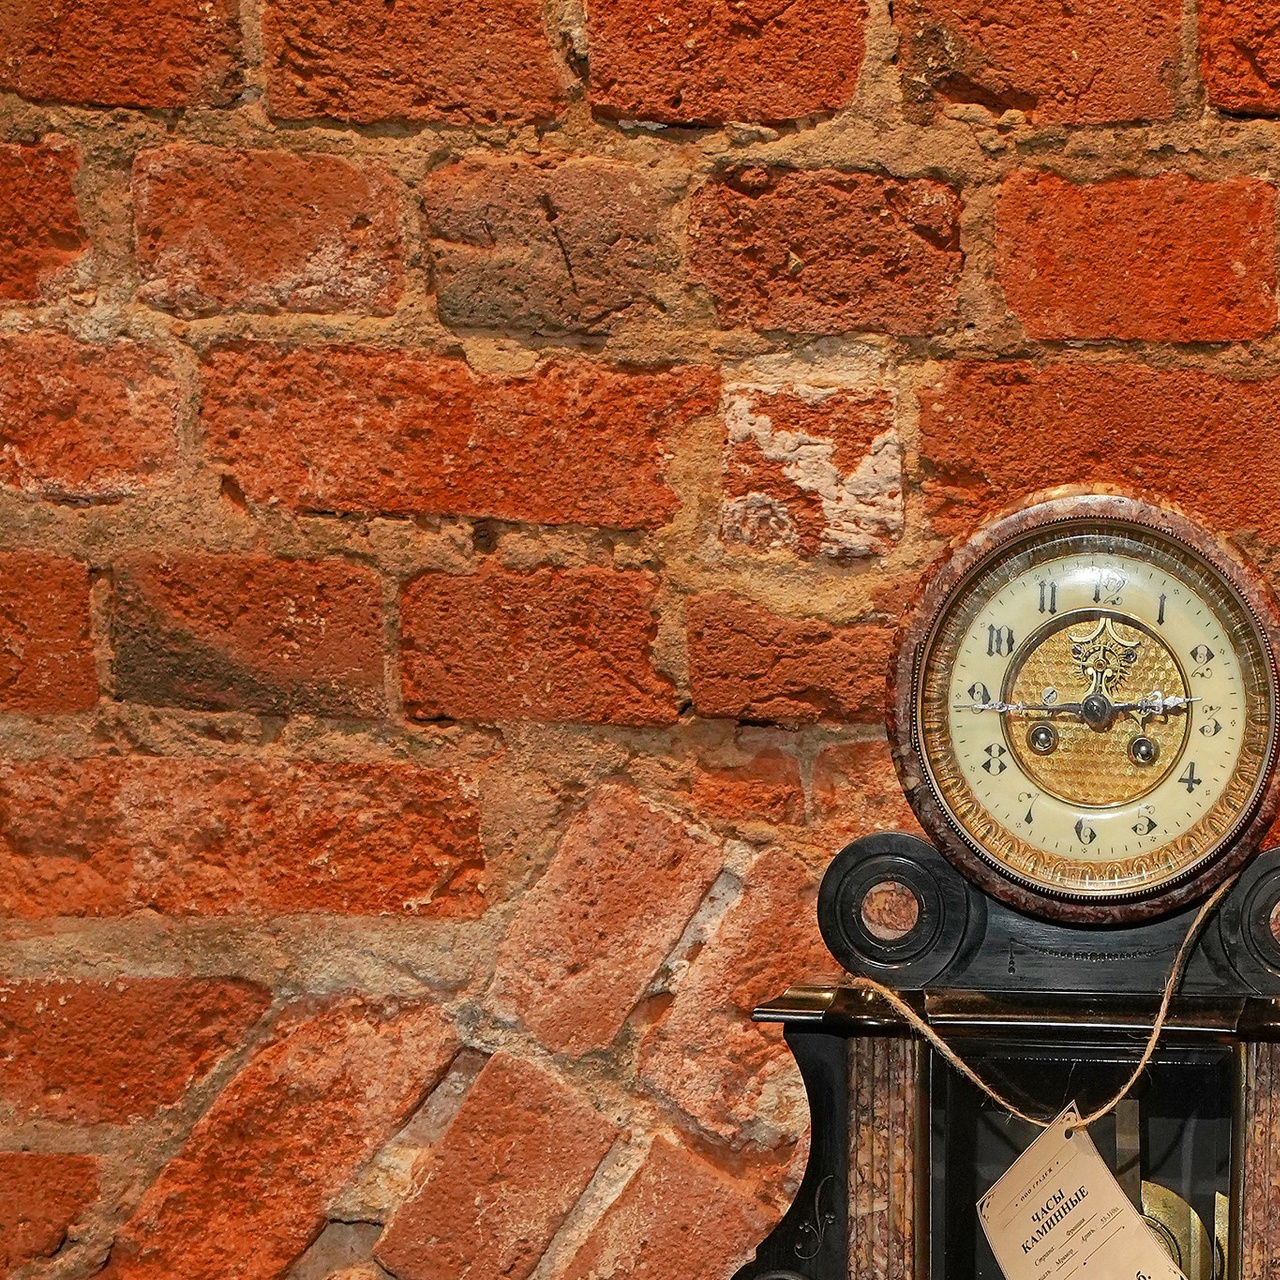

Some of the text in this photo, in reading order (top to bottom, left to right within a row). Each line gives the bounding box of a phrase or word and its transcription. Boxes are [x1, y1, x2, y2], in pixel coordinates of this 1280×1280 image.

[1038, 580, 1058, 615] 11
[987, 623, 1015, 658] 10
[1190, 643, 1215, 679] 2
[1200, 704, 1223, 738] 3
[981, 742, 1008, 776] 8
[1177, 761, 1203, 795] 4
[1017, 791, 1041, 825] 7
[1131, 804, 1158, 837] 5
[1073, 816, 1098, 846] 6
[1021, 1185, 1089, 1255] КАМИННЫЕ
[1031, 1188, 1065, 1224] ЧАСЫ
